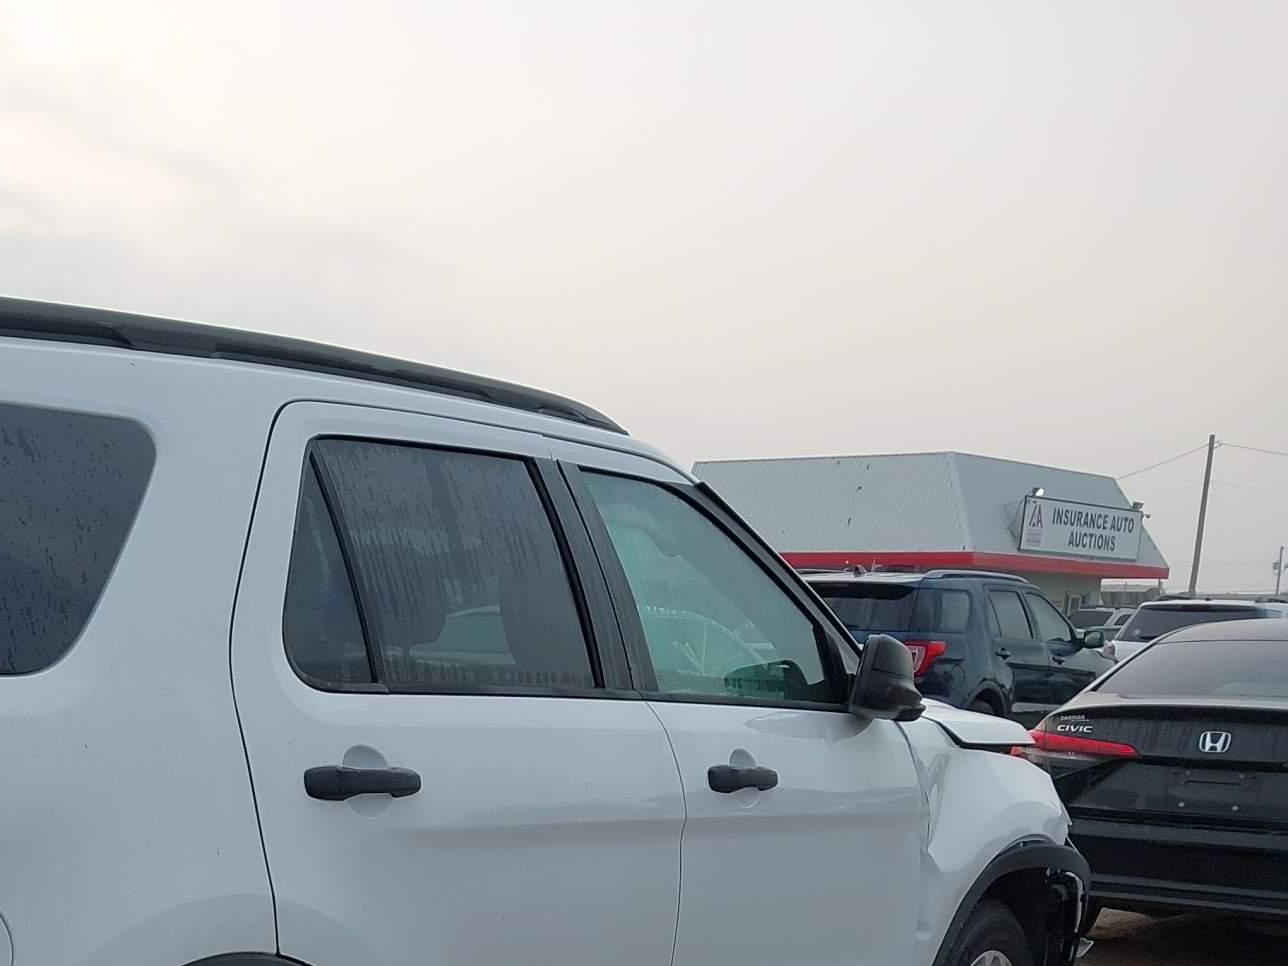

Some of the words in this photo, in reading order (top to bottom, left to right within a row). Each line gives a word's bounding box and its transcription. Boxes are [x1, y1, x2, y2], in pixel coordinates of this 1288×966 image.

[1052, 507, 1109, 530] INSURANCE
[1109, 515, 1134, 533] AUTO
[1068, 531, 1116, 552] AUCTIONS
[1057, 724, 1093, 733] CIVIC
